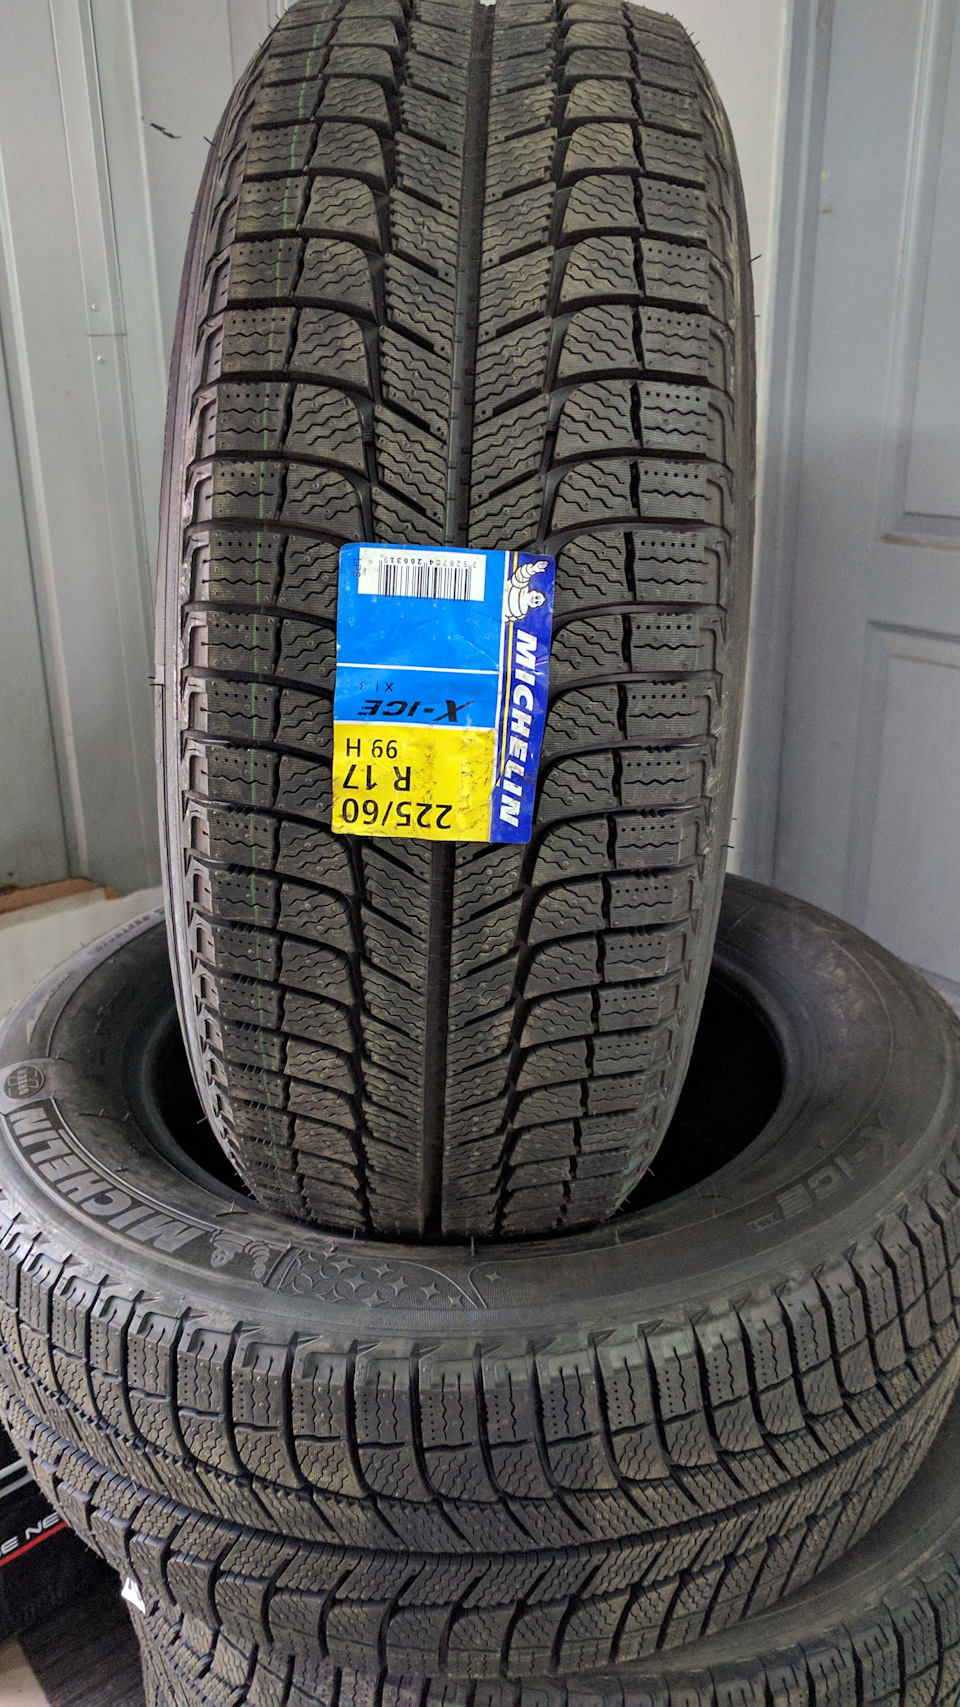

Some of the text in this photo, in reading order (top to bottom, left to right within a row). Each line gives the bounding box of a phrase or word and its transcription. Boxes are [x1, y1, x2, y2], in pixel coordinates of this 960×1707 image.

[383, 557, 422, 565] 266319
[429, 559, 468, 568] 528704
[358, 700, 475, 722] X-ICE
[499, 629, 538, 827] MICHELIN
[346, 738, 398, 759] 99 H
[343, 764, 411, 791] R 17
[342, 798, 452, 829] 225/60
[11, 1106, 203, 1253] MICHELIN
